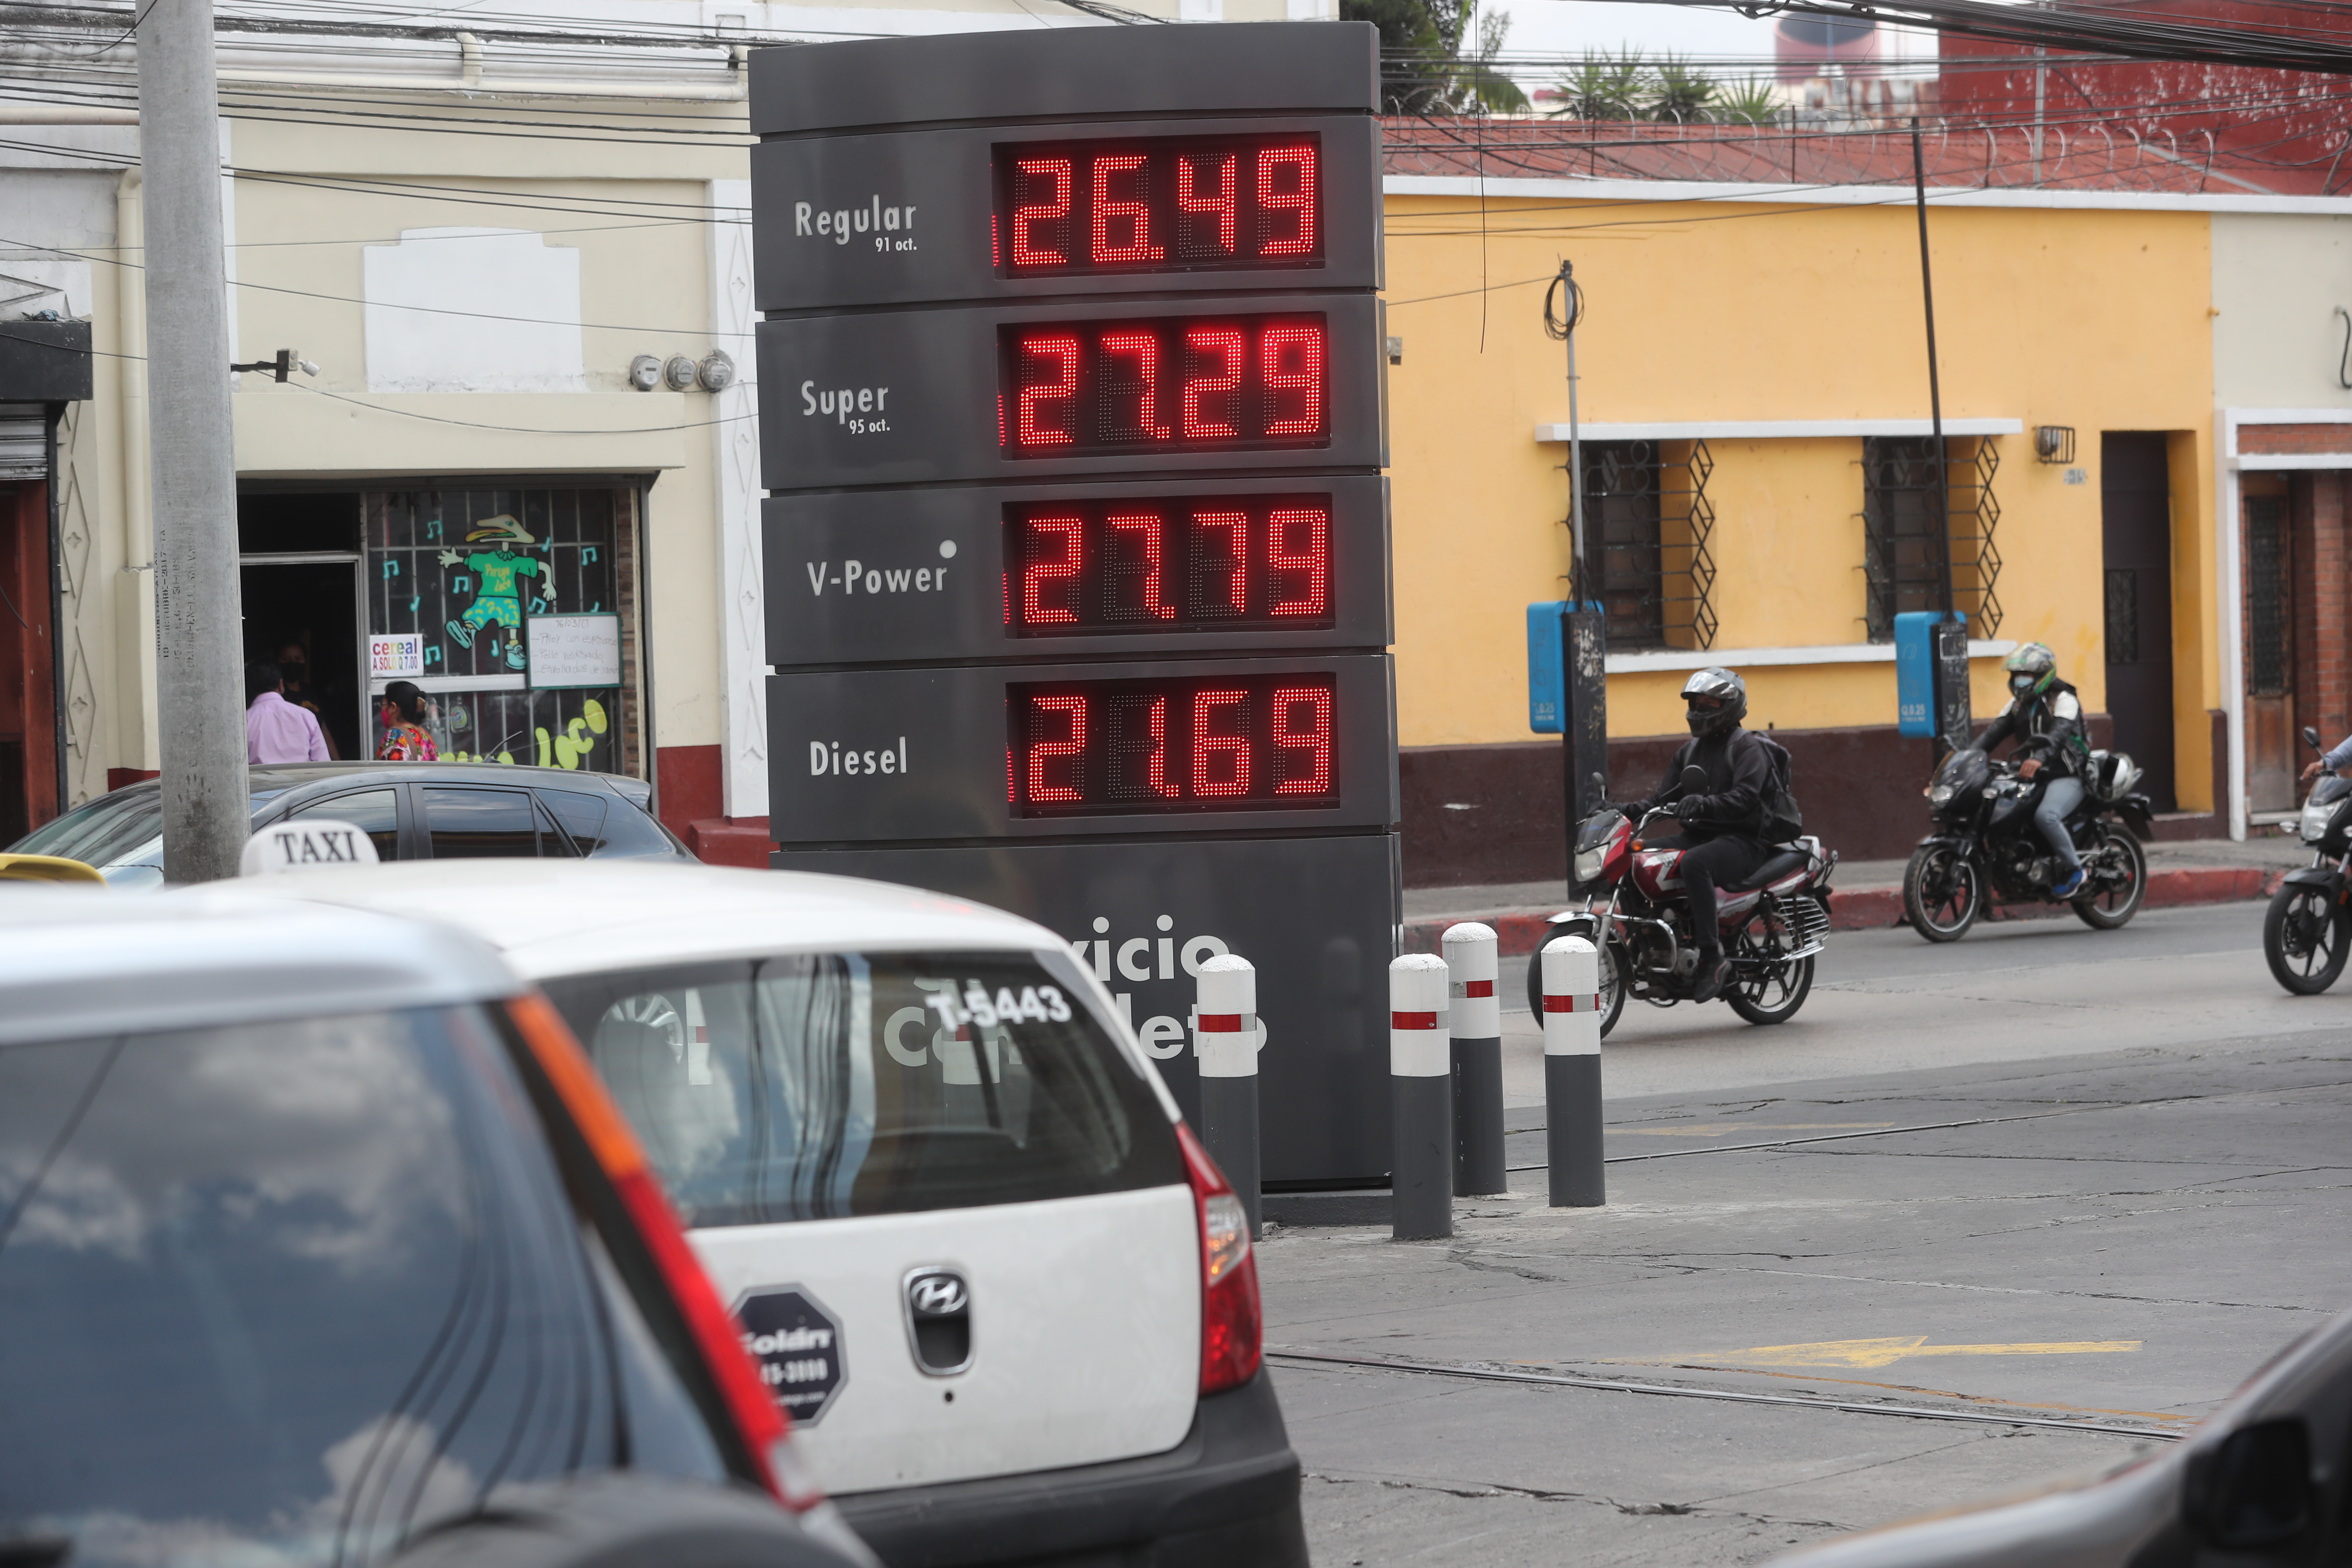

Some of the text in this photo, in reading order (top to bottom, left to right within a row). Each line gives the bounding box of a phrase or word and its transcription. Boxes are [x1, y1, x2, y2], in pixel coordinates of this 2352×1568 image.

[795, 194, 916, 245] Regular
[1013, 147, 1315, 266] 26.49
[875, 237, 917, 252] 91 oct.
[801, 380, 888, 425] Super
[1019, 327, 1321, 445] 27.29
[849, 419, 891, 435] 95 oct.
[806, 560, 947, 596] V-Power
[1024, 509, 1326, 624] 27.79
[373, 638, 417, 655] cereal
[373, 656, 418, 671] A SOLO Q 7.00
[810, 736, 906, 775] Diesel
[1029, 687, 1331, 802] 21.69
[275, 830, 360, 864] TAXI
